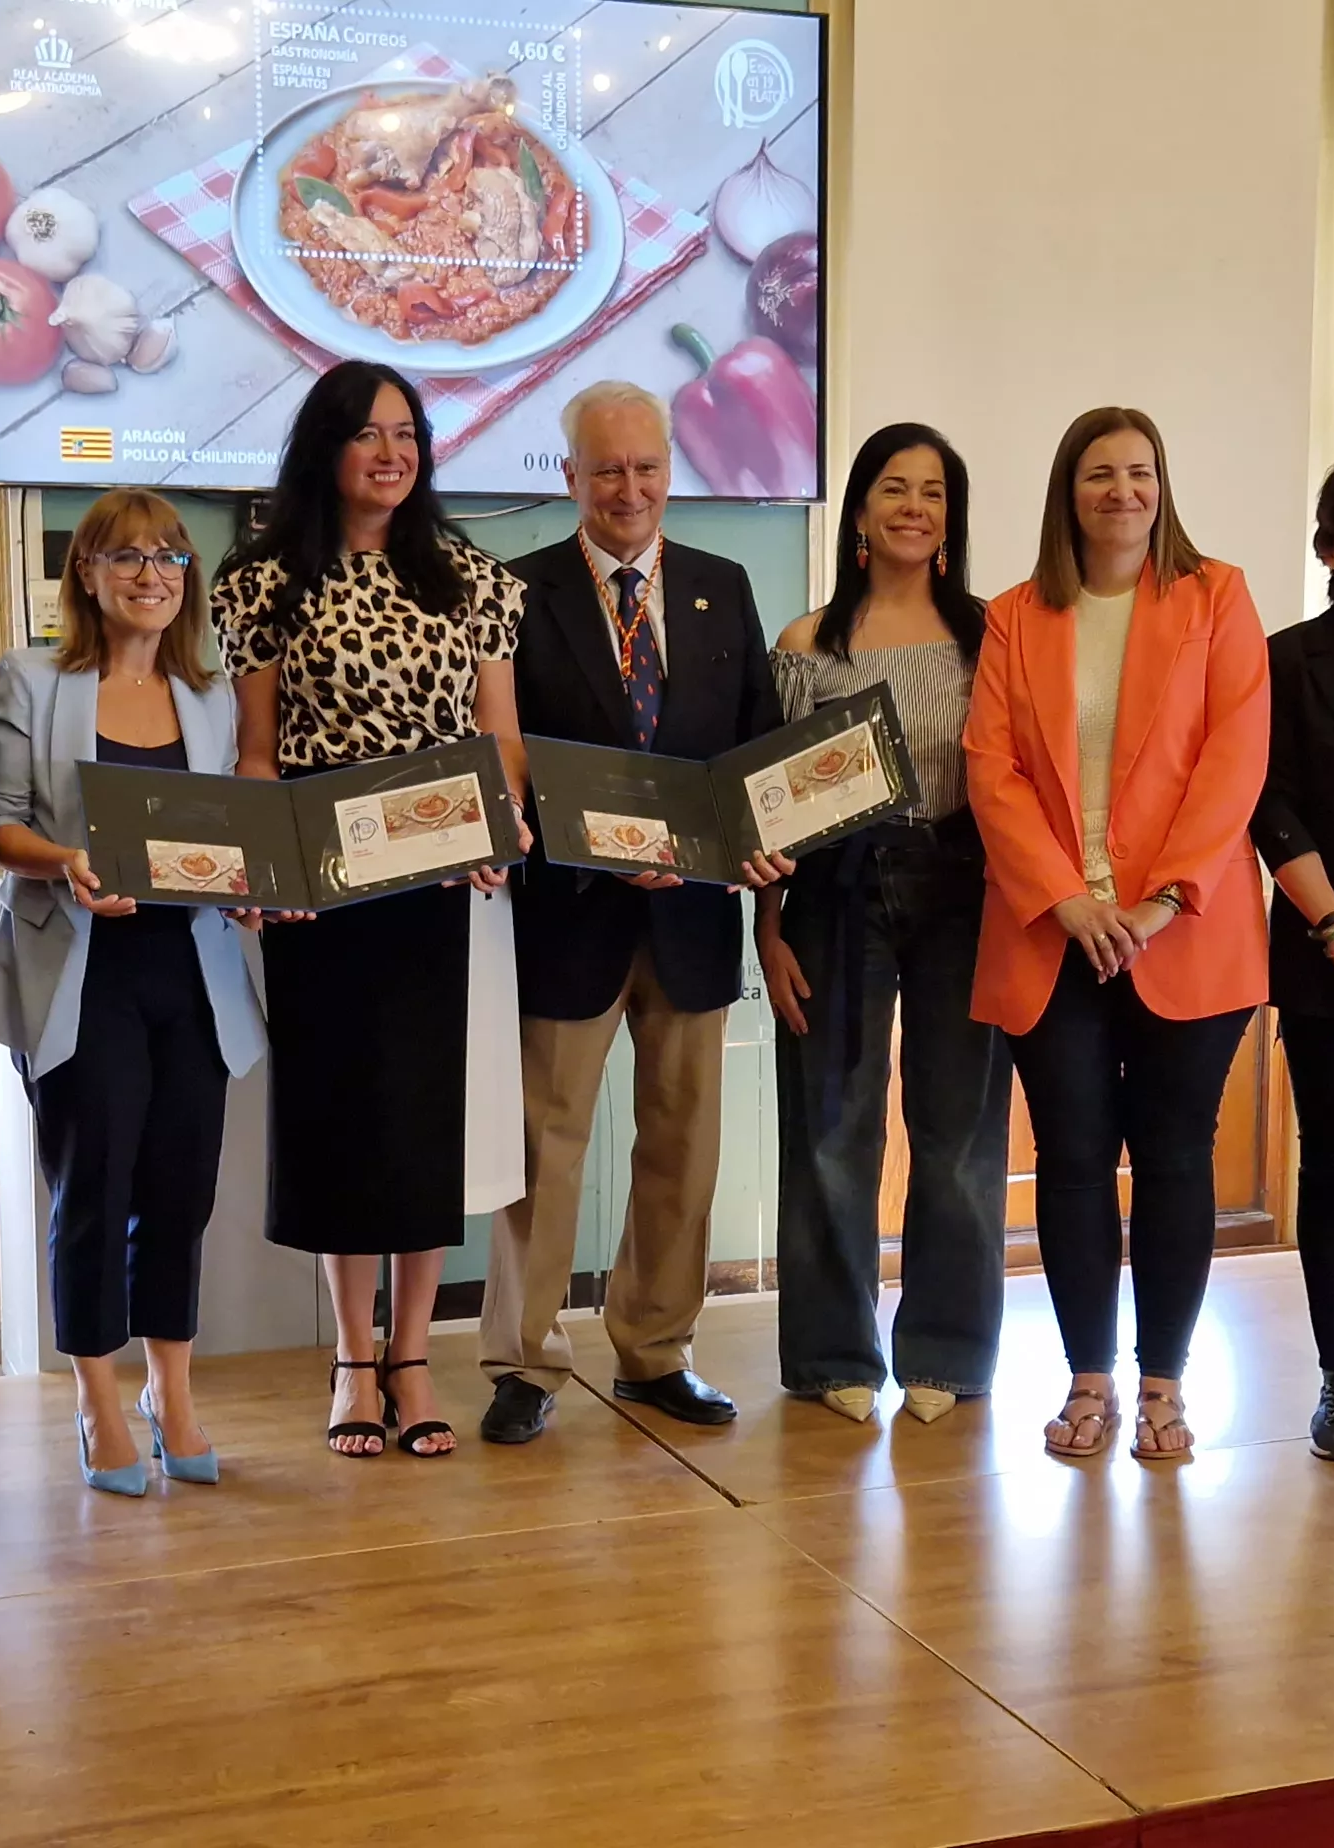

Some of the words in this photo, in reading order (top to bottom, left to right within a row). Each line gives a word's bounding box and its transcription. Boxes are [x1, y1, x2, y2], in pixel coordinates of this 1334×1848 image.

[269, 21, 340, 43] ESPAÑA
[343, 26, 408, 47] Correos
[271, 45, 359, 63] GASTRONOMÍA
[508, 40, 548, 61] 4,60
[551, 44, 565, 63] €
[13, 68, 40, 82] REAL
[44, 71, 98, 85] ACADEMIA
[272, 62, 315, 77] ESPAÑA
[316, 66, 331, 78] EN
[273, 76, 287, 88] 19
[288, 77, 328, 90] PLATOS
[542, 71, 552, 88] AL
[542, 91, 552, 131] POLLO
[554, 72, 567, 150] CHILINDRÓN
[122, 428, 186, 444] ARAGÓN
[122, 449, 168, 462] POLLO
[171, 450, 189, 463] AL
[191, 449, 278, 465] CHILINDRÓN
